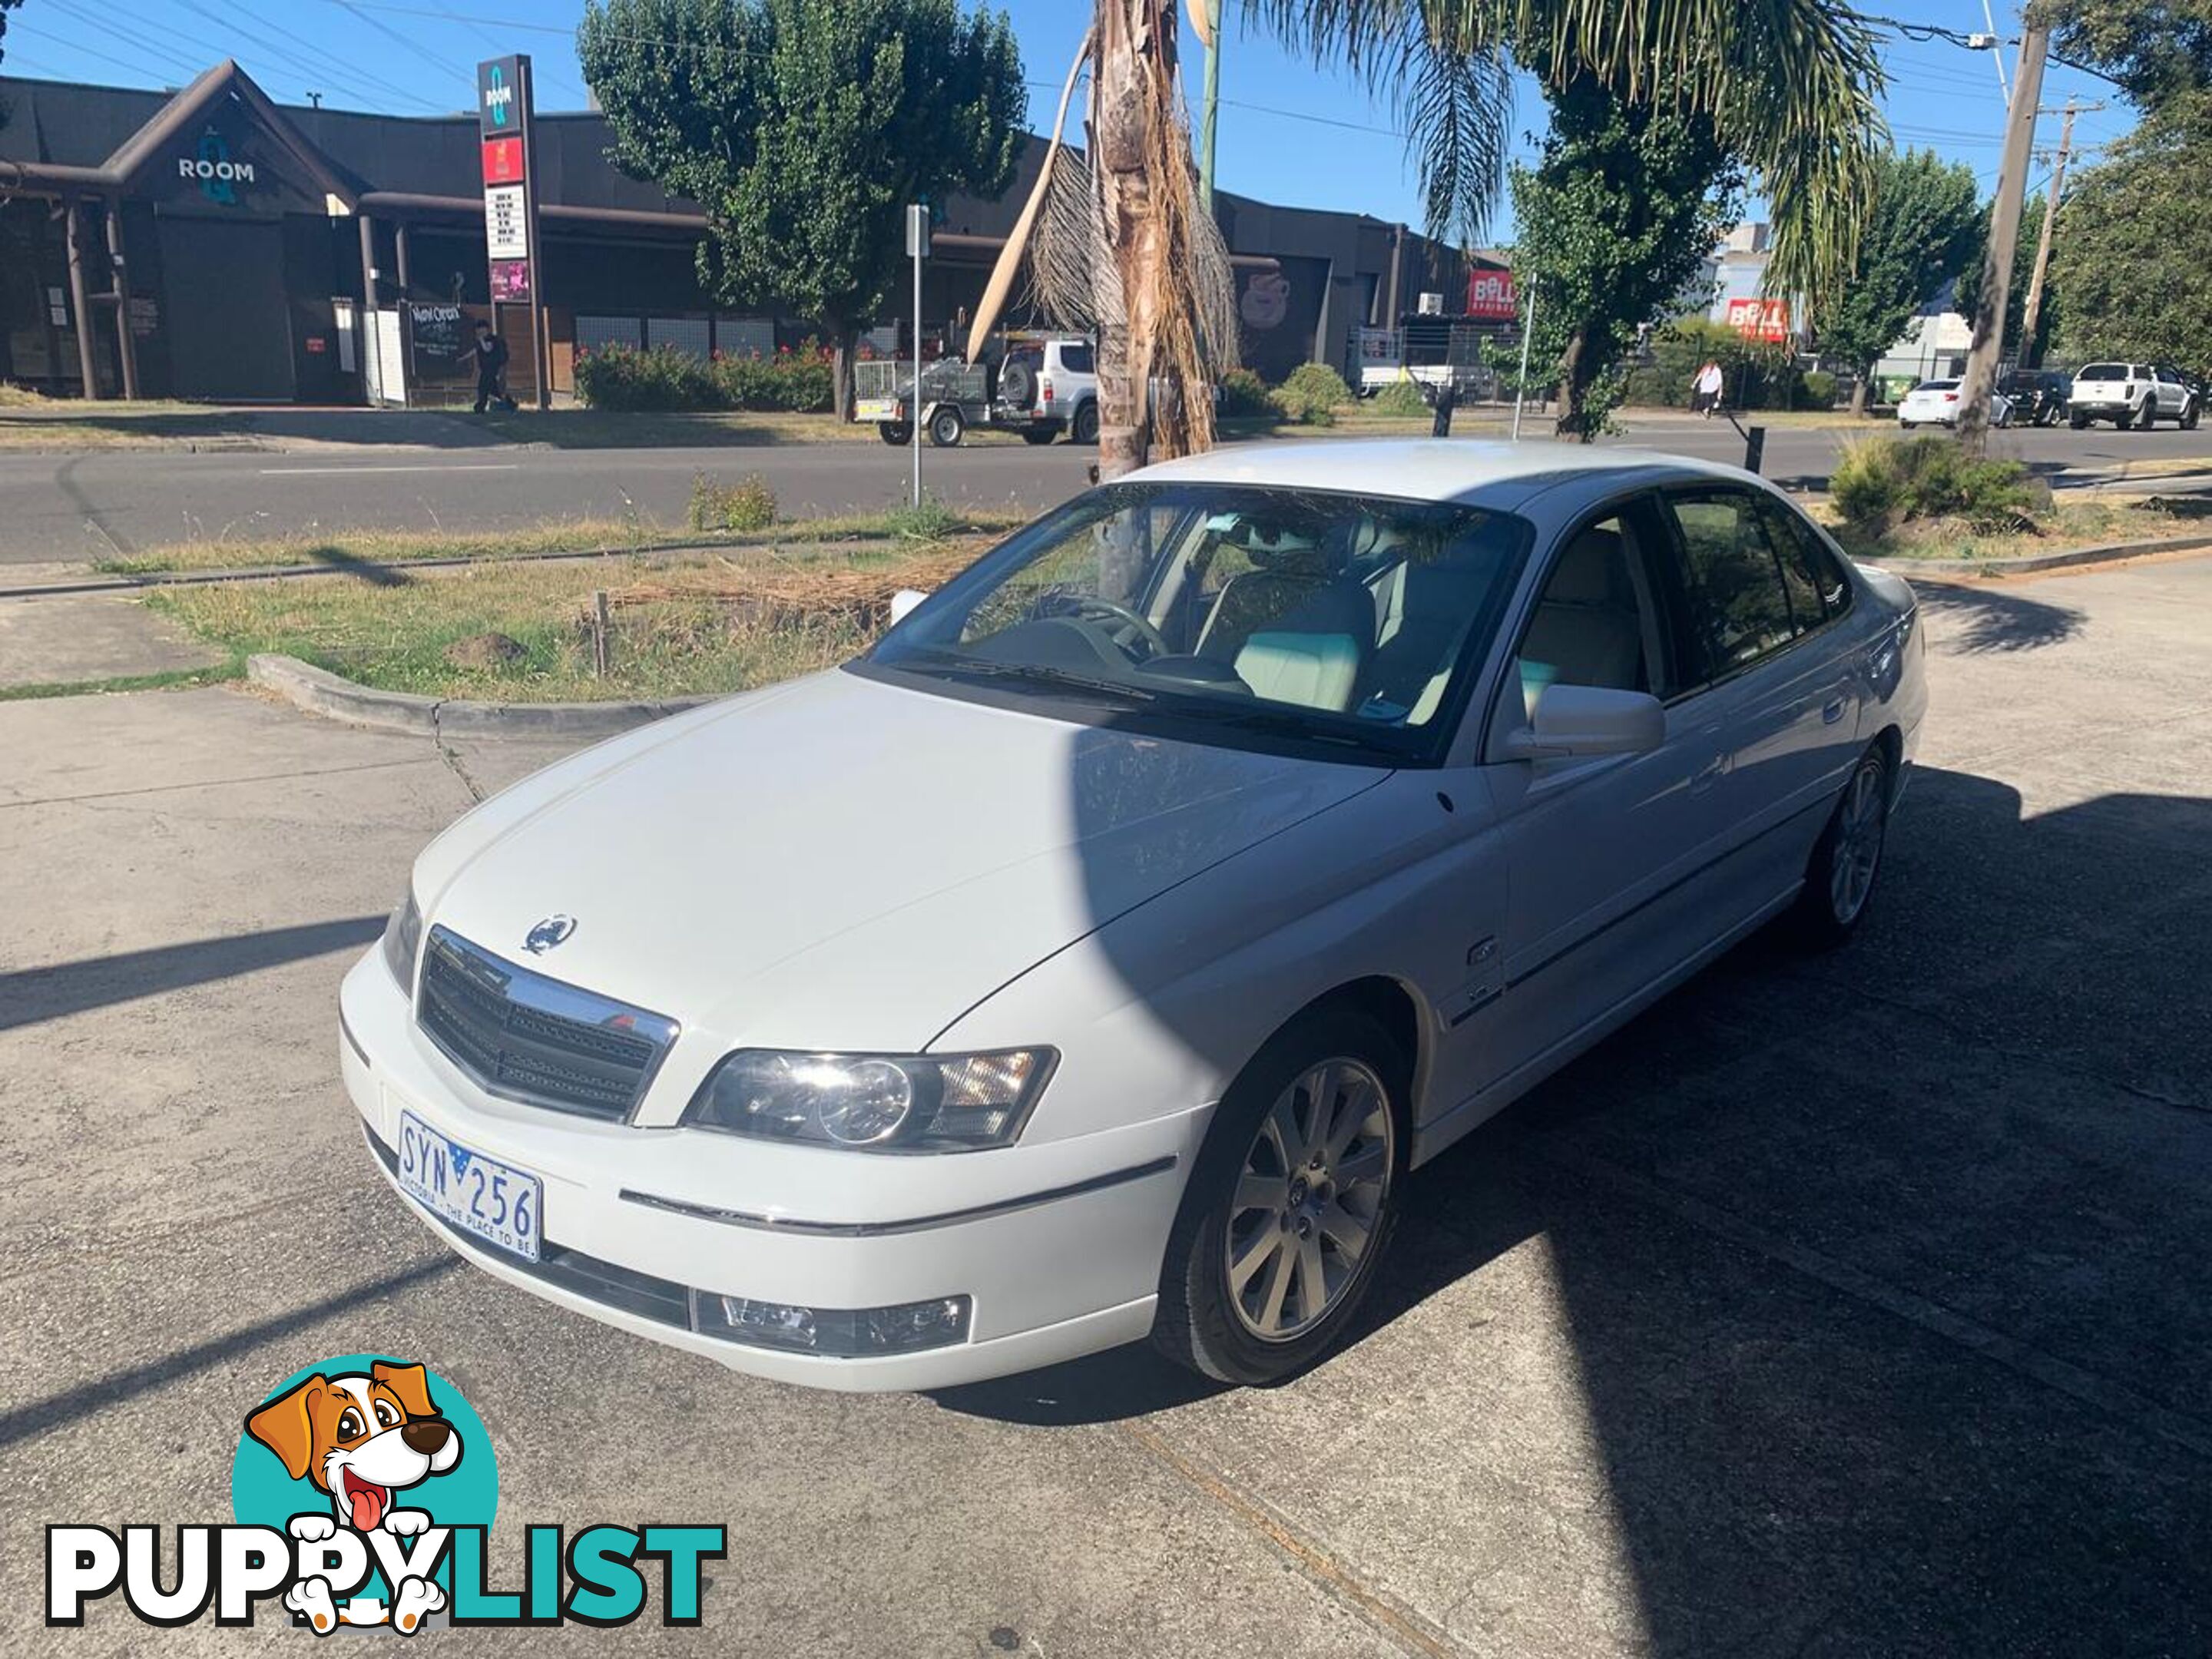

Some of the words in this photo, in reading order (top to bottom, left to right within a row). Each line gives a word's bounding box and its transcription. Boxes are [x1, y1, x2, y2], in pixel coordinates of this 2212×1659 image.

[485, 87, 512, 107] ROOM
[179, 158, 254, 183] ROOM
[403, 1126, 446, 1195] SYN
[472, 1167, 530, 1237] 256
[447, 1204, 462, 1221] THE
[466, 1214, 494, 1238] PLACE
[499, 1231, 512, 1246] TO
